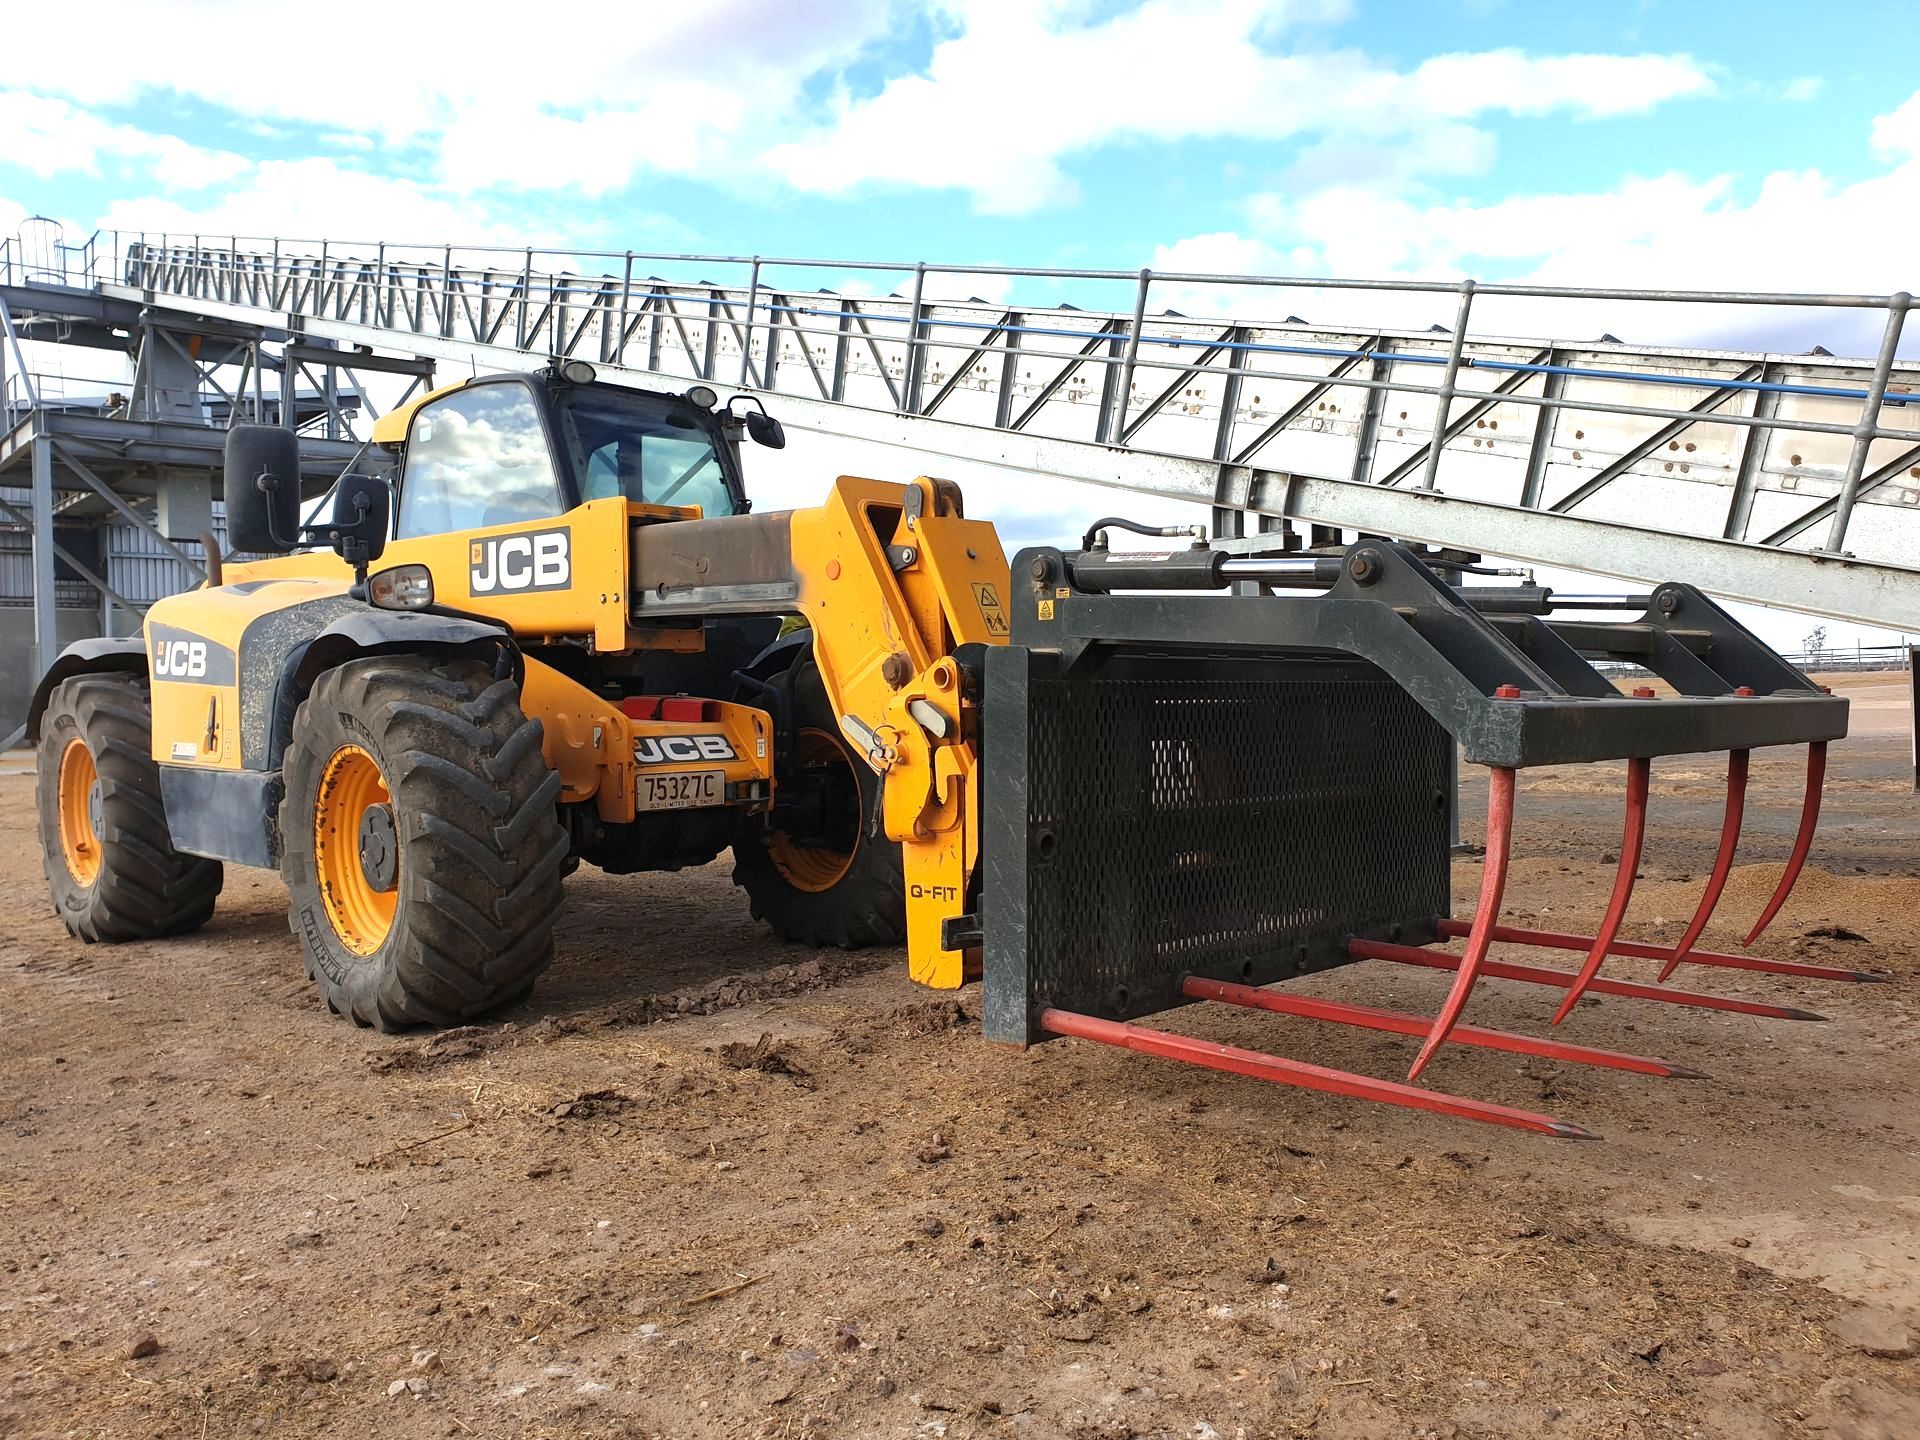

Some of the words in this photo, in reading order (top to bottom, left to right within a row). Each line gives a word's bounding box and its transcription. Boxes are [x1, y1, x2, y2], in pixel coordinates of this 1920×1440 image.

[472, 532, 569, 592] JCB
[156, 641, 206, 677] JCB
[634, 736, 735, 763] JCB
[644, 775, 715, 802] 75327C
[910, 884, 957, 902] Q-FIT
[302, 911, 339, 977] MICHELIN
